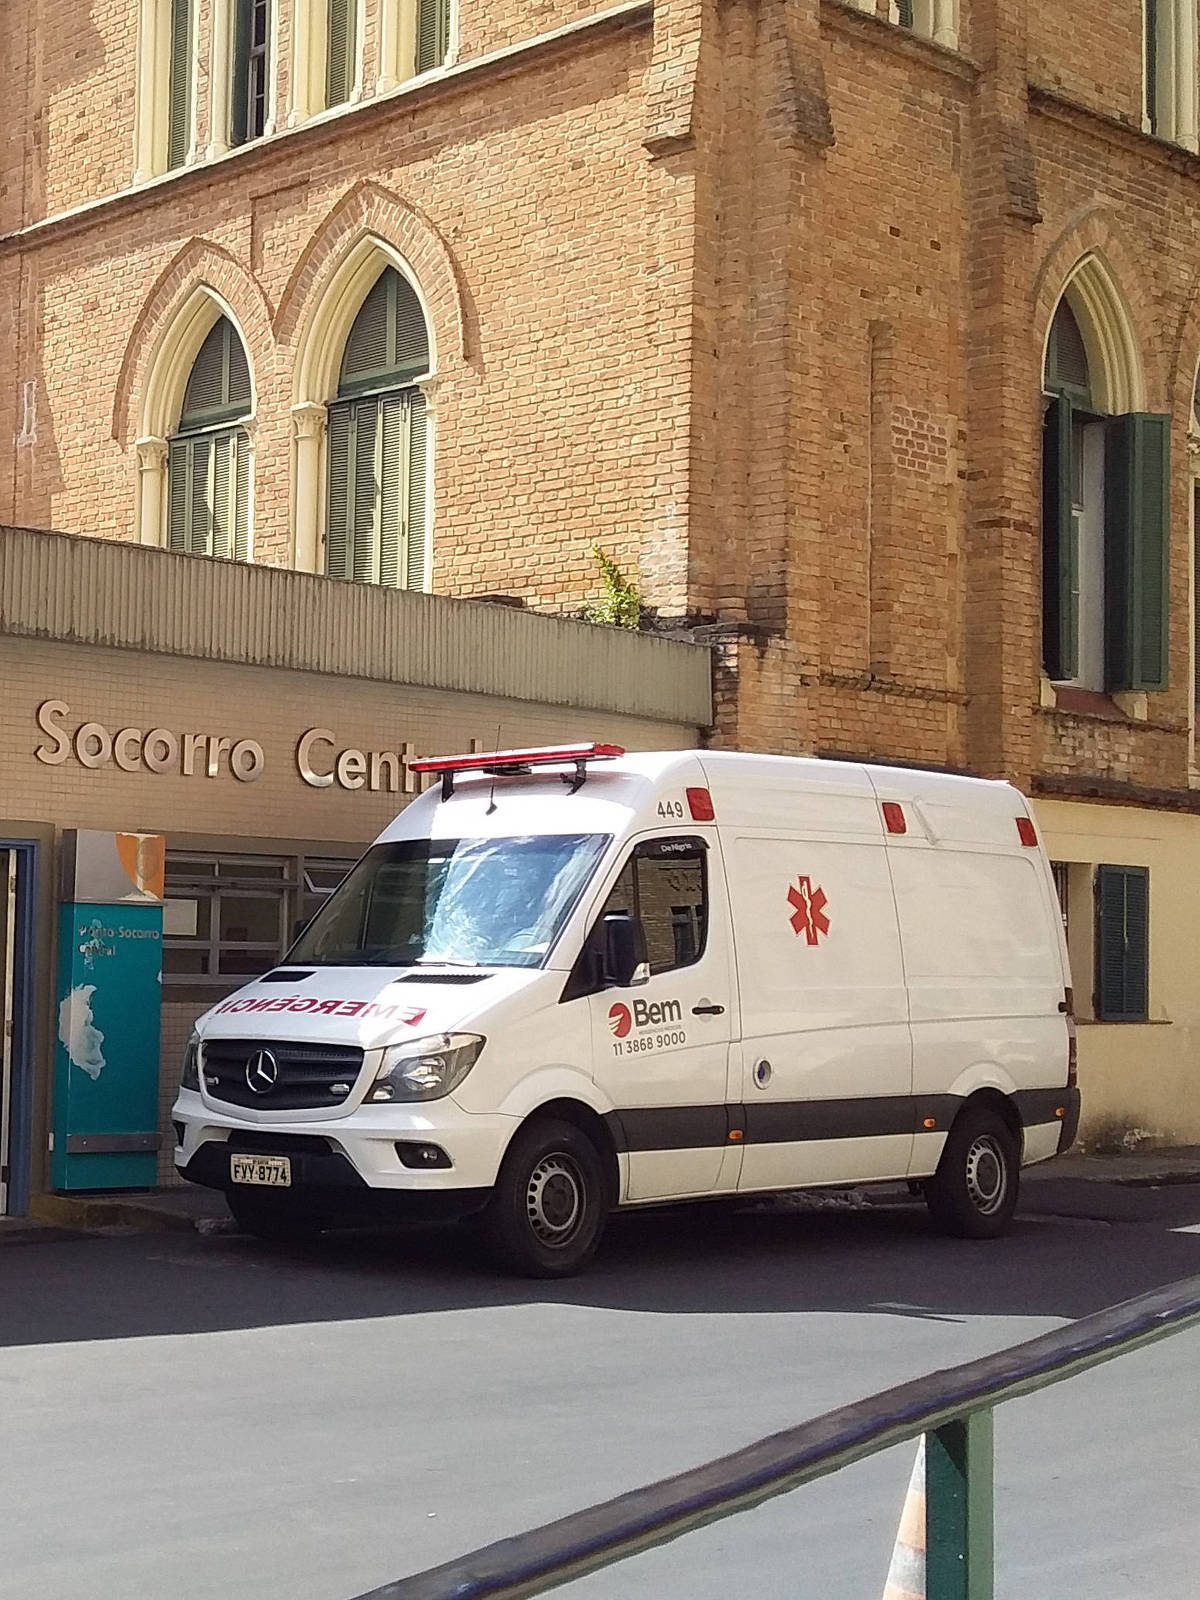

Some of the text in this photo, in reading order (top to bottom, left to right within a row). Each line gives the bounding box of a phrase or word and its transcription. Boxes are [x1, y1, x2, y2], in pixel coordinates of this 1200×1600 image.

[33, 699, 265, 783] Socorro
[297, 727, 483, 793] Cent
[657, 801, 683, 818] 449
[79, 925, 160, 940] Ponto Socorro
[632, 999, 682, 1027] Bem
[612, 1031, 686, 1056] 11 3868 9000
